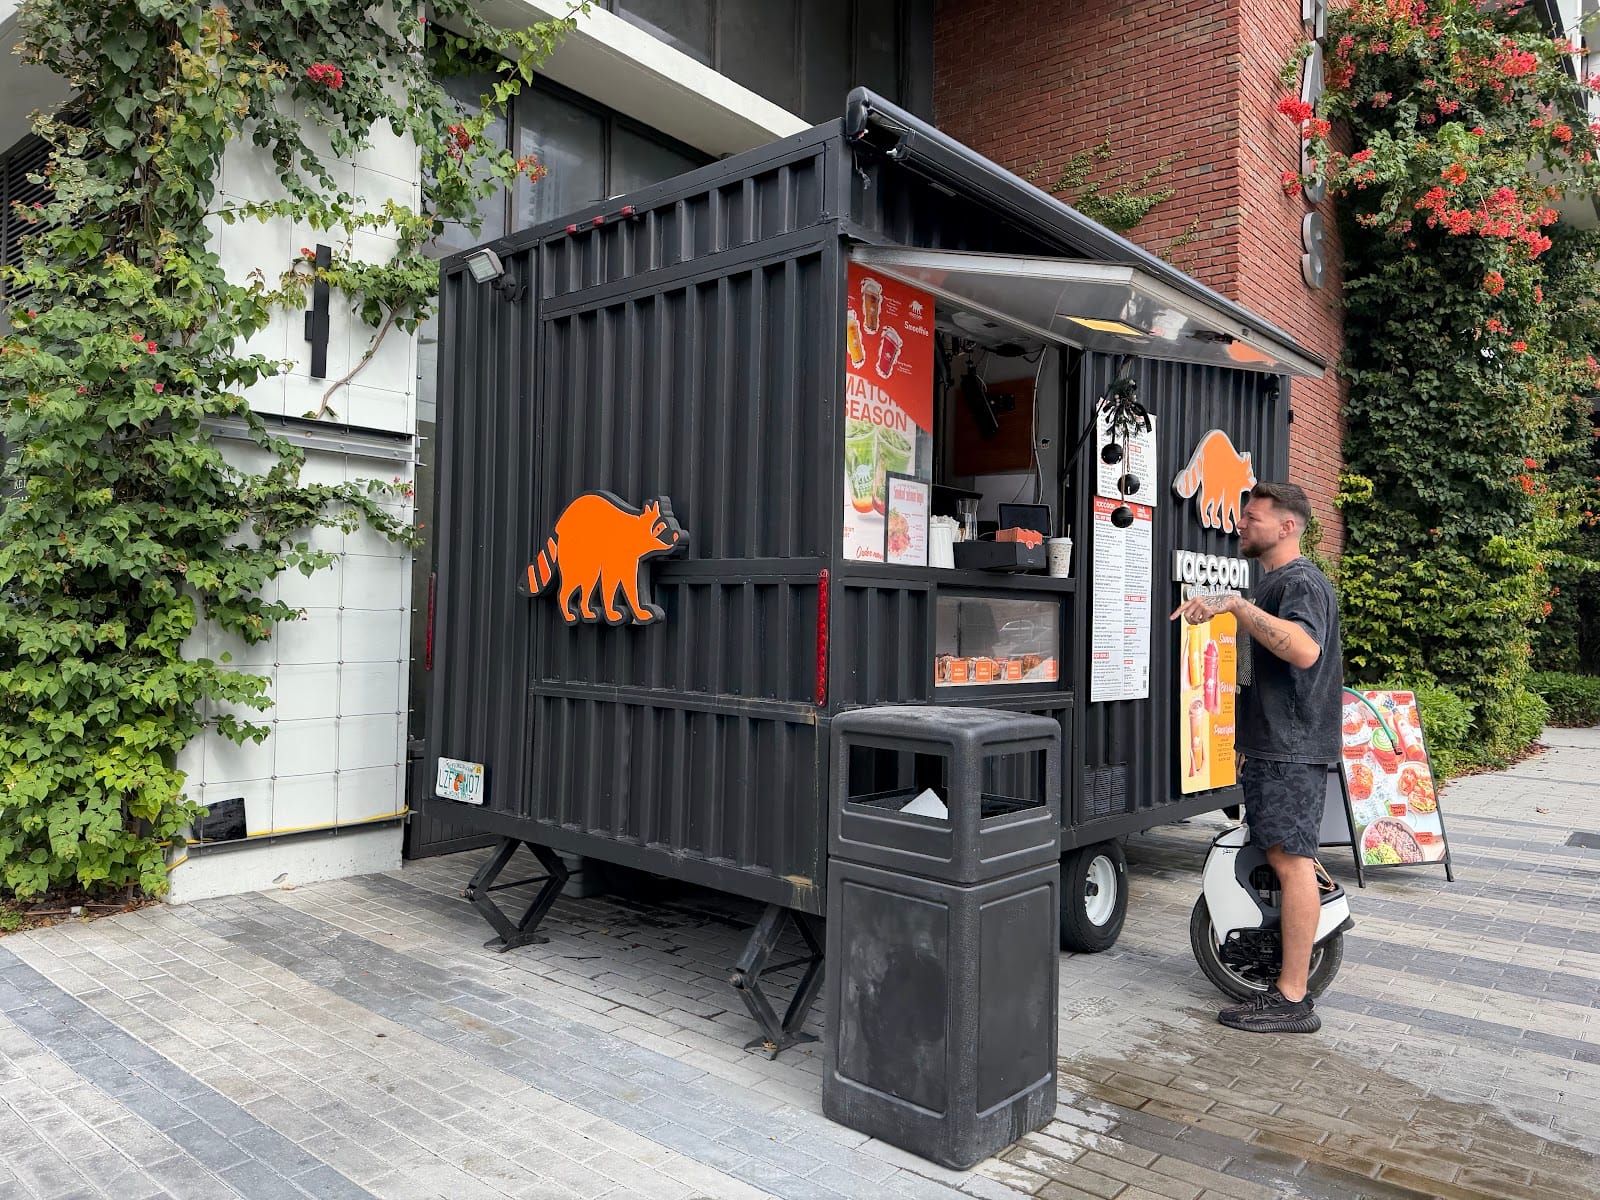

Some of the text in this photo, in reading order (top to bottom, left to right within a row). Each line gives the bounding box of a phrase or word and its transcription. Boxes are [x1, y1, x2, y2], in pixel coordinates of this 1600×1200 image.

[904, 320, 929, 337] Smoothie
[847, 375, 893, 406] MATC
[1172, 550, 1249, 589] raccoon
